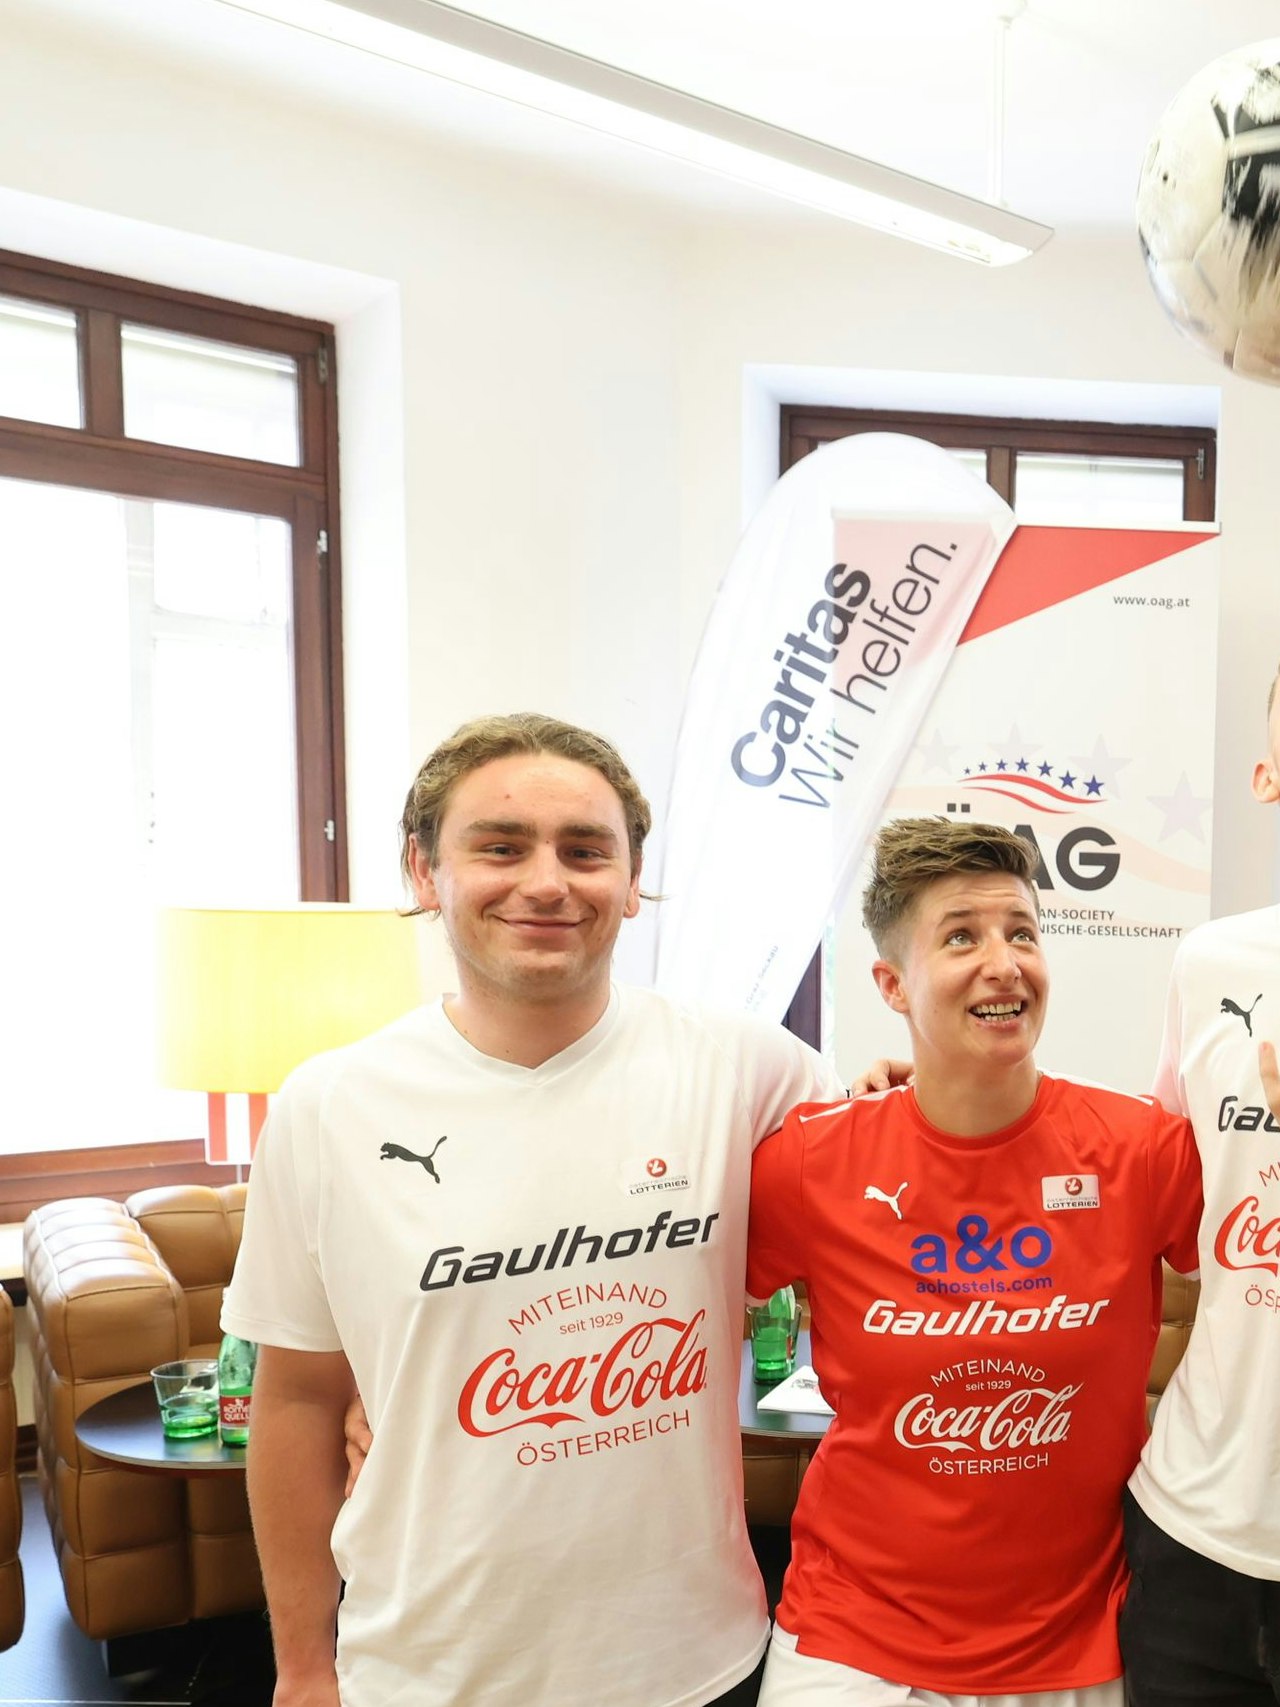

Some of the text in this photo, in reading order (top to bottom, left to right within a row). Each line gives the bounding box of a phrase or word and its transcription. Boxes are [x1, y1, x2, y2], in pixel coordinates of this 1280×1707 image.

[1113, 595, 1190, 609] www.oag.at
[730, 562, 871, 788] Caritas
[778, 541, 958, 810] Wir helfen.
[629, 1179, 688, 1195] LOTTERIEN
[1047, 1200, 1098, 1209] LOTTERIEN
[419, 1210, 720, 1292] Gaulhofer
[910, 1215, 1053, 1274] a&o
[915, 1276, 1053, 1295] aohostels.com
[508, 1282, 668, 1335] MITEINAND
[559, 1311, 624, 1335] seit 1929
[863, 1294, 1110, 1336] Gaulhofer
[457, 1308, 708, 1438] Coca-Cola
[930, 1358, 1046, 1388] MITEINAND
[965, 1379, 1012, 1391] seit 1929
[516, 1409, 691, 1466] ÖSTERREICH
[893, 1381, 1084, 1453] Coca-Cola
[929, 1452, 1049, 1476] ÖSTERREICH
